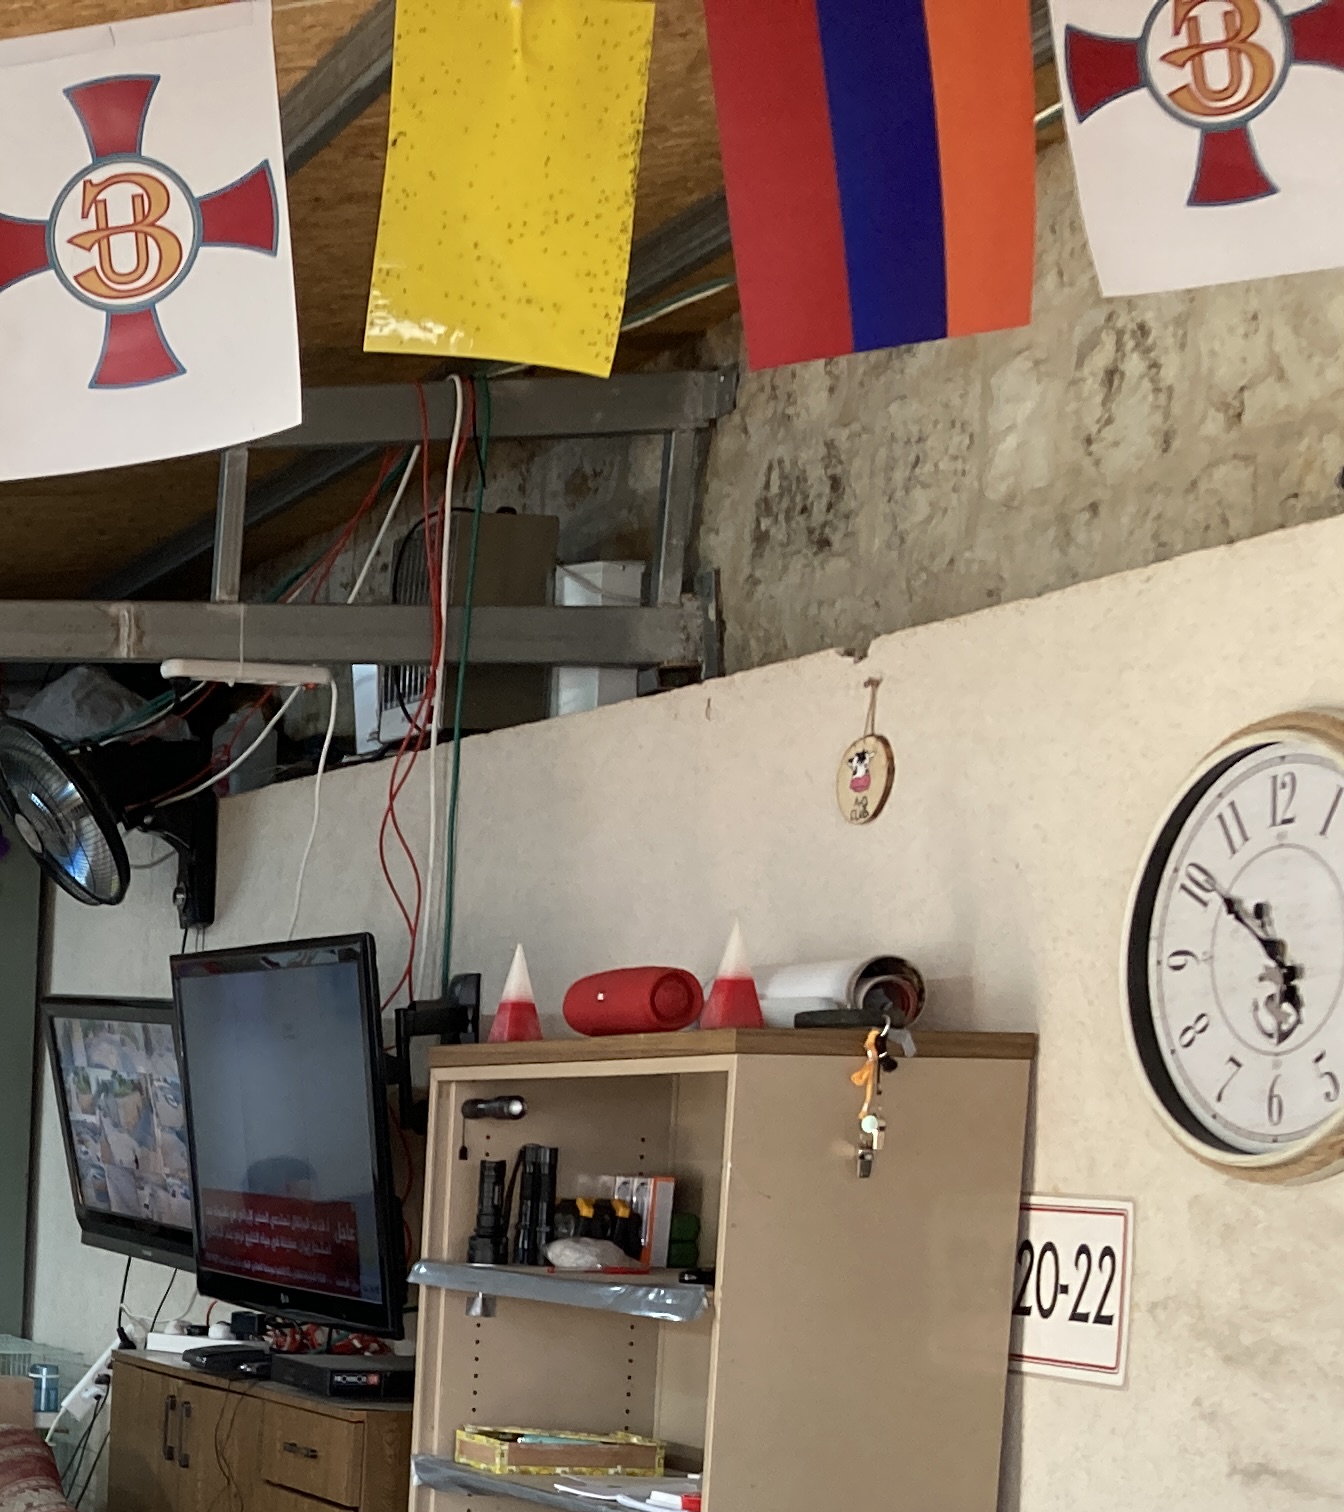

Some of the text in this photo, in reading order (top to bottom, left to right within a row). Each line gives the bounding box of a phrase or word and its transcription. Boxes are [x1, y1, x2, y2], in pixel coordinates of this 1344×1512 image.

[1269, 771, 1297, 828] 12
[1216, 800, 1251, 858] 11
[1178, 862, 1217, 910] 10
[1167, 950, 1213, 971] 9
[1179, 1013, 1210, 1048] 8
[1216, 1056, 1244, 1103] 7
[1268, 1074, 1283, 1126] 6
[1313, 1050, 1340, 1103] 5
[1012, 1239, 1116, 1326] 20-22
